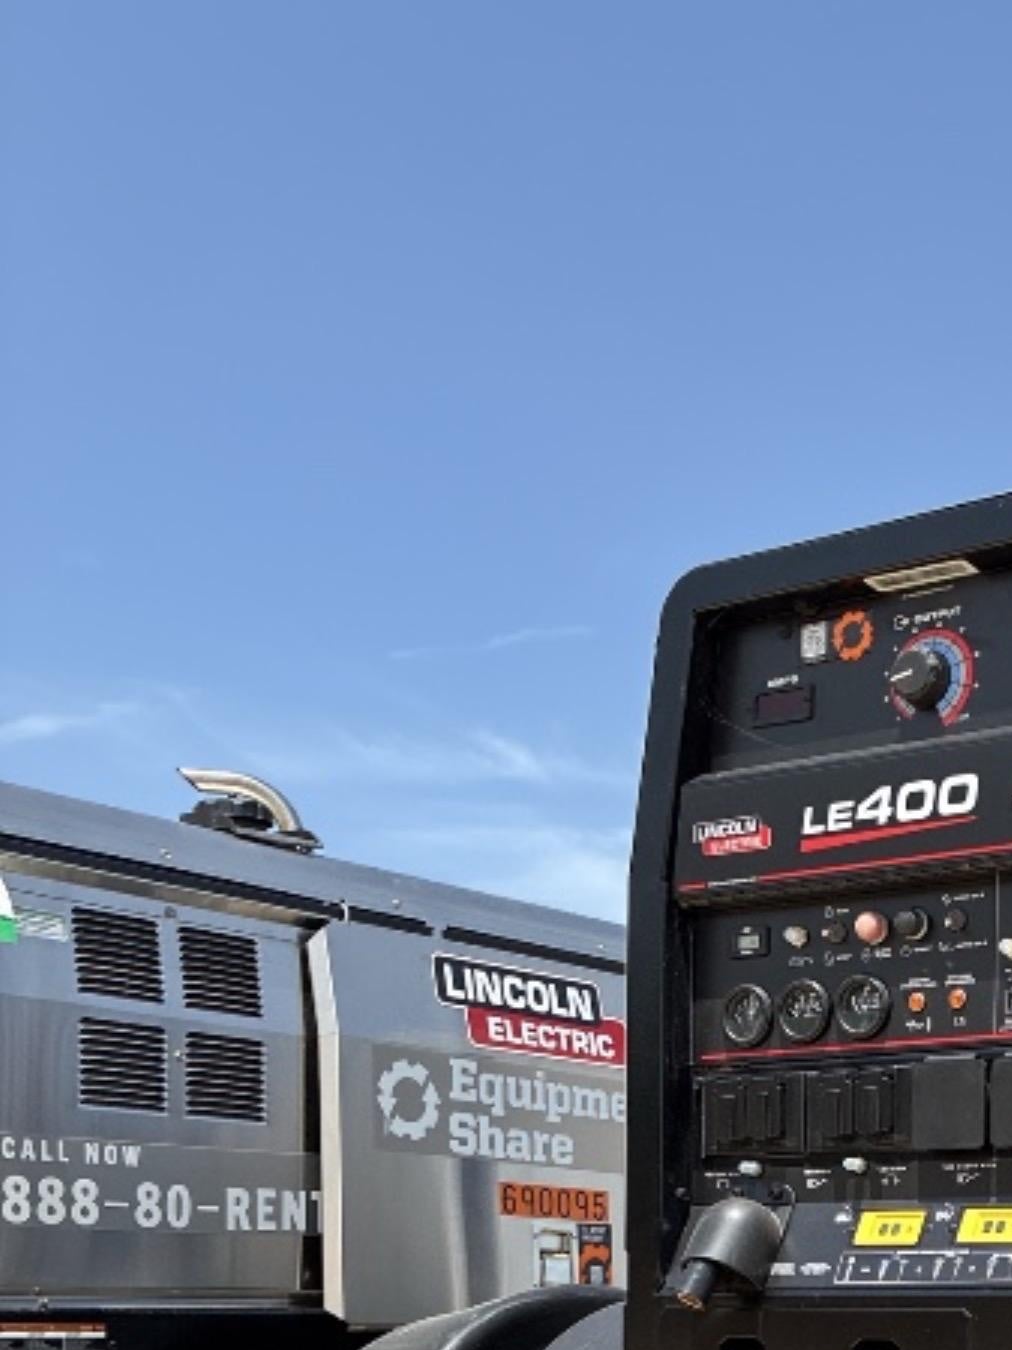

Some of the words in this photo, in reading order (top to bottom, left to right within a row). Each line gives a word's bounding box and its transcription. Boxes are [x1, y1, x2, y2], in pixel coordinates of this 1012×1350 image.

[802, 773, 979, 835] LE400
[443, 962, 594, 1021] LINCOLN
[487, 1016, 616, 1060] ELECTRIC
[449, 1058, 625, 1123] Equipme
[1, 1136, 70, 1163] CALL
[85, 1141, 142, 1168] NOW
[449, 1111, 574, 1165] Share
[2, 1175, 321, 1232] 888-80-RENT
[502, 1184, 606, 1221] 690095
